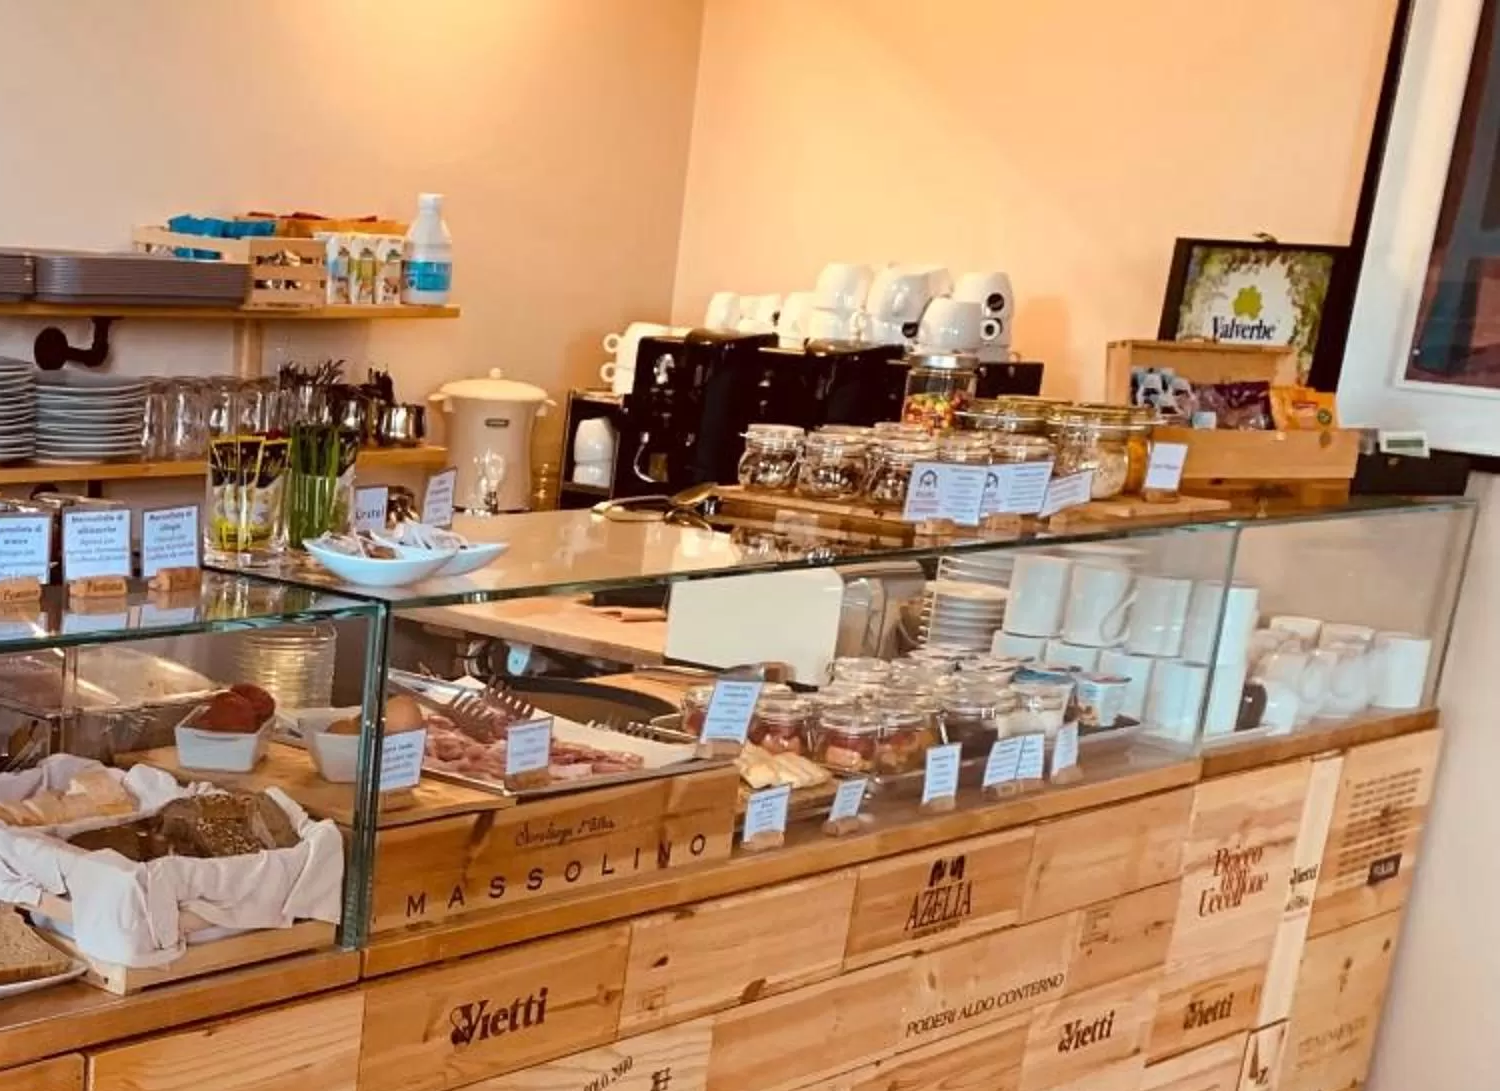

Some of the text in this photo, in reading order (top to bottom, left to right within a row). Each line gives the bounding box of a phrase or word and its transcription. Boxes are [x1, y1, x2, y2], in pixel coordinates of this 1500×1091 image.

[1211, 315, 1277, 341] Valverbe
[405, 833, 707, 918] MASSOLINO
[903, 880, 973, 931] AZELIA
[450, 987, 549, 1044] Vietti
[905, 972, 1065, 1039] PODERI ALDO CONTERNO
[1183, 991, 1235, 1031] Vietti
[1057, 1010, 1116, 1053] Vietti
